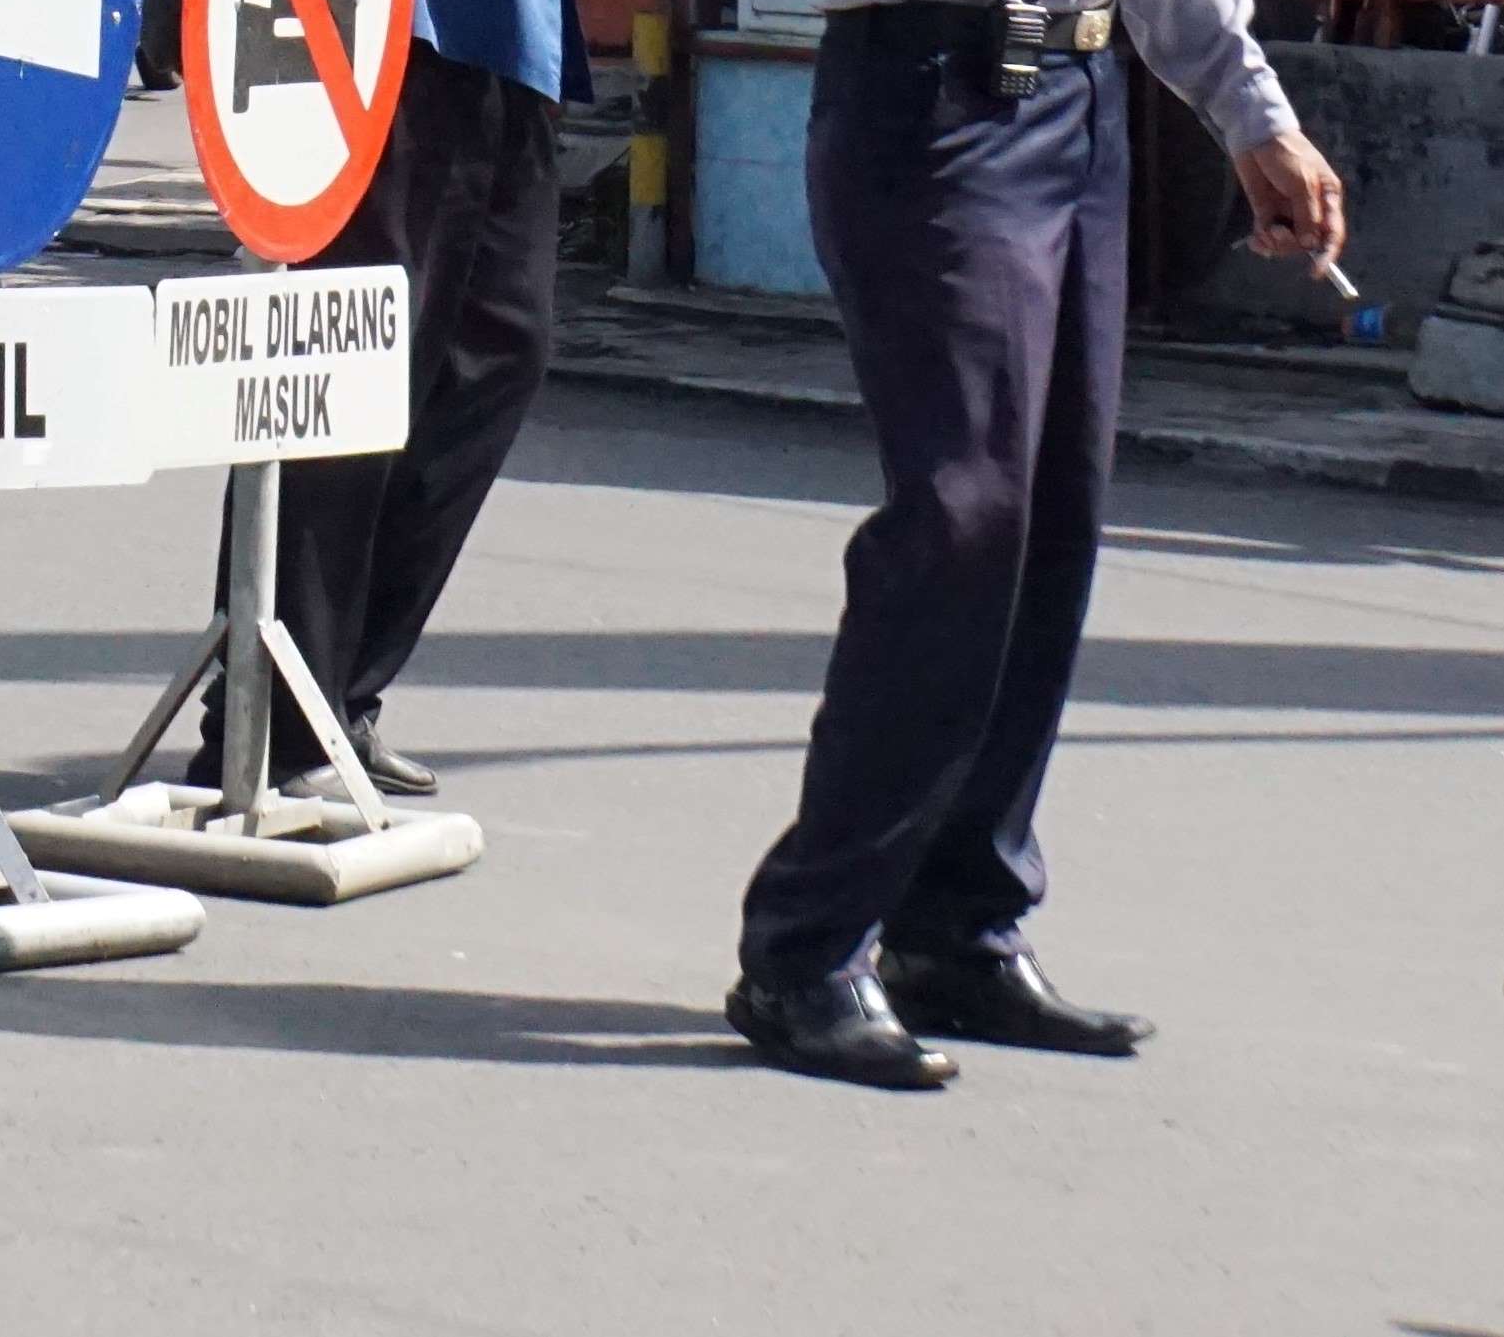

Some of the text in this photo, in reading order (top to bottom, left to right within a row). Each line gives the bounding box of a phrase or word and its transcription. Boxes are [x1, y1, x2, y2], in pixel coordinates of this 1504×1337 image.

[168, 285, 397, 367] MOBIL DILARANG
[233, 372, 332, 443] MASUK
